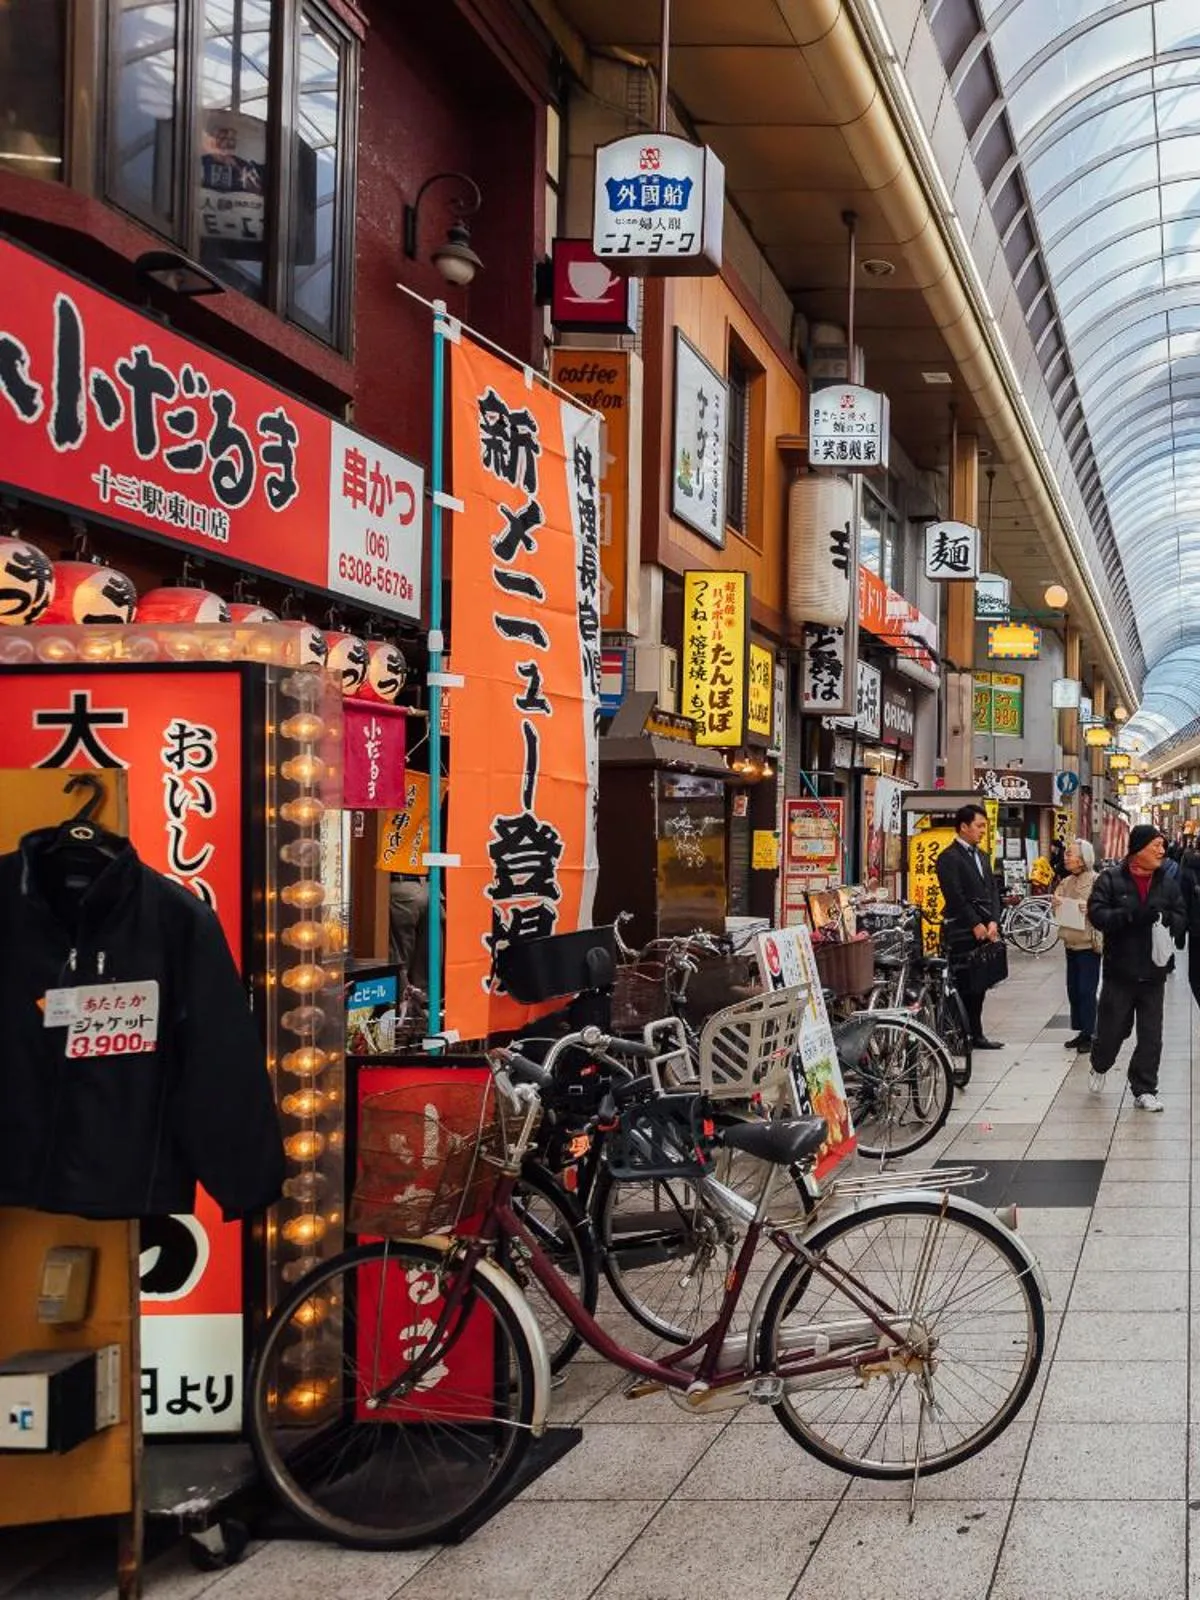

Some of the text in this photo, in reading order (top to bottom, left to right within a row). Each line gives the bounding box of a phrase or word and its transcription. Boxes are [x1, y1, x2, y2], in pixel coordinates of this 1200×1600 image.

[600, 232, 695, 253] ニューヨーク
[558, 363, 618, 384] coffee
[0, 292, 300, 512] 小だるま
[92, 465, 229, 543] 十三駅東口店
[342, 446, 416, 527] 串かつ
[365, 534, 390, 563] (06)
[929, 531, 971, 572] 麺
[338, 562, 407, 601] 6308-5678
[708, 643, 734, 733] たんぽぽ
[363, 717, 382, 800] 小だるま
[84, 994, 146, 1013] あたたか
[73, 1015, 154, 1034] ジャケット
